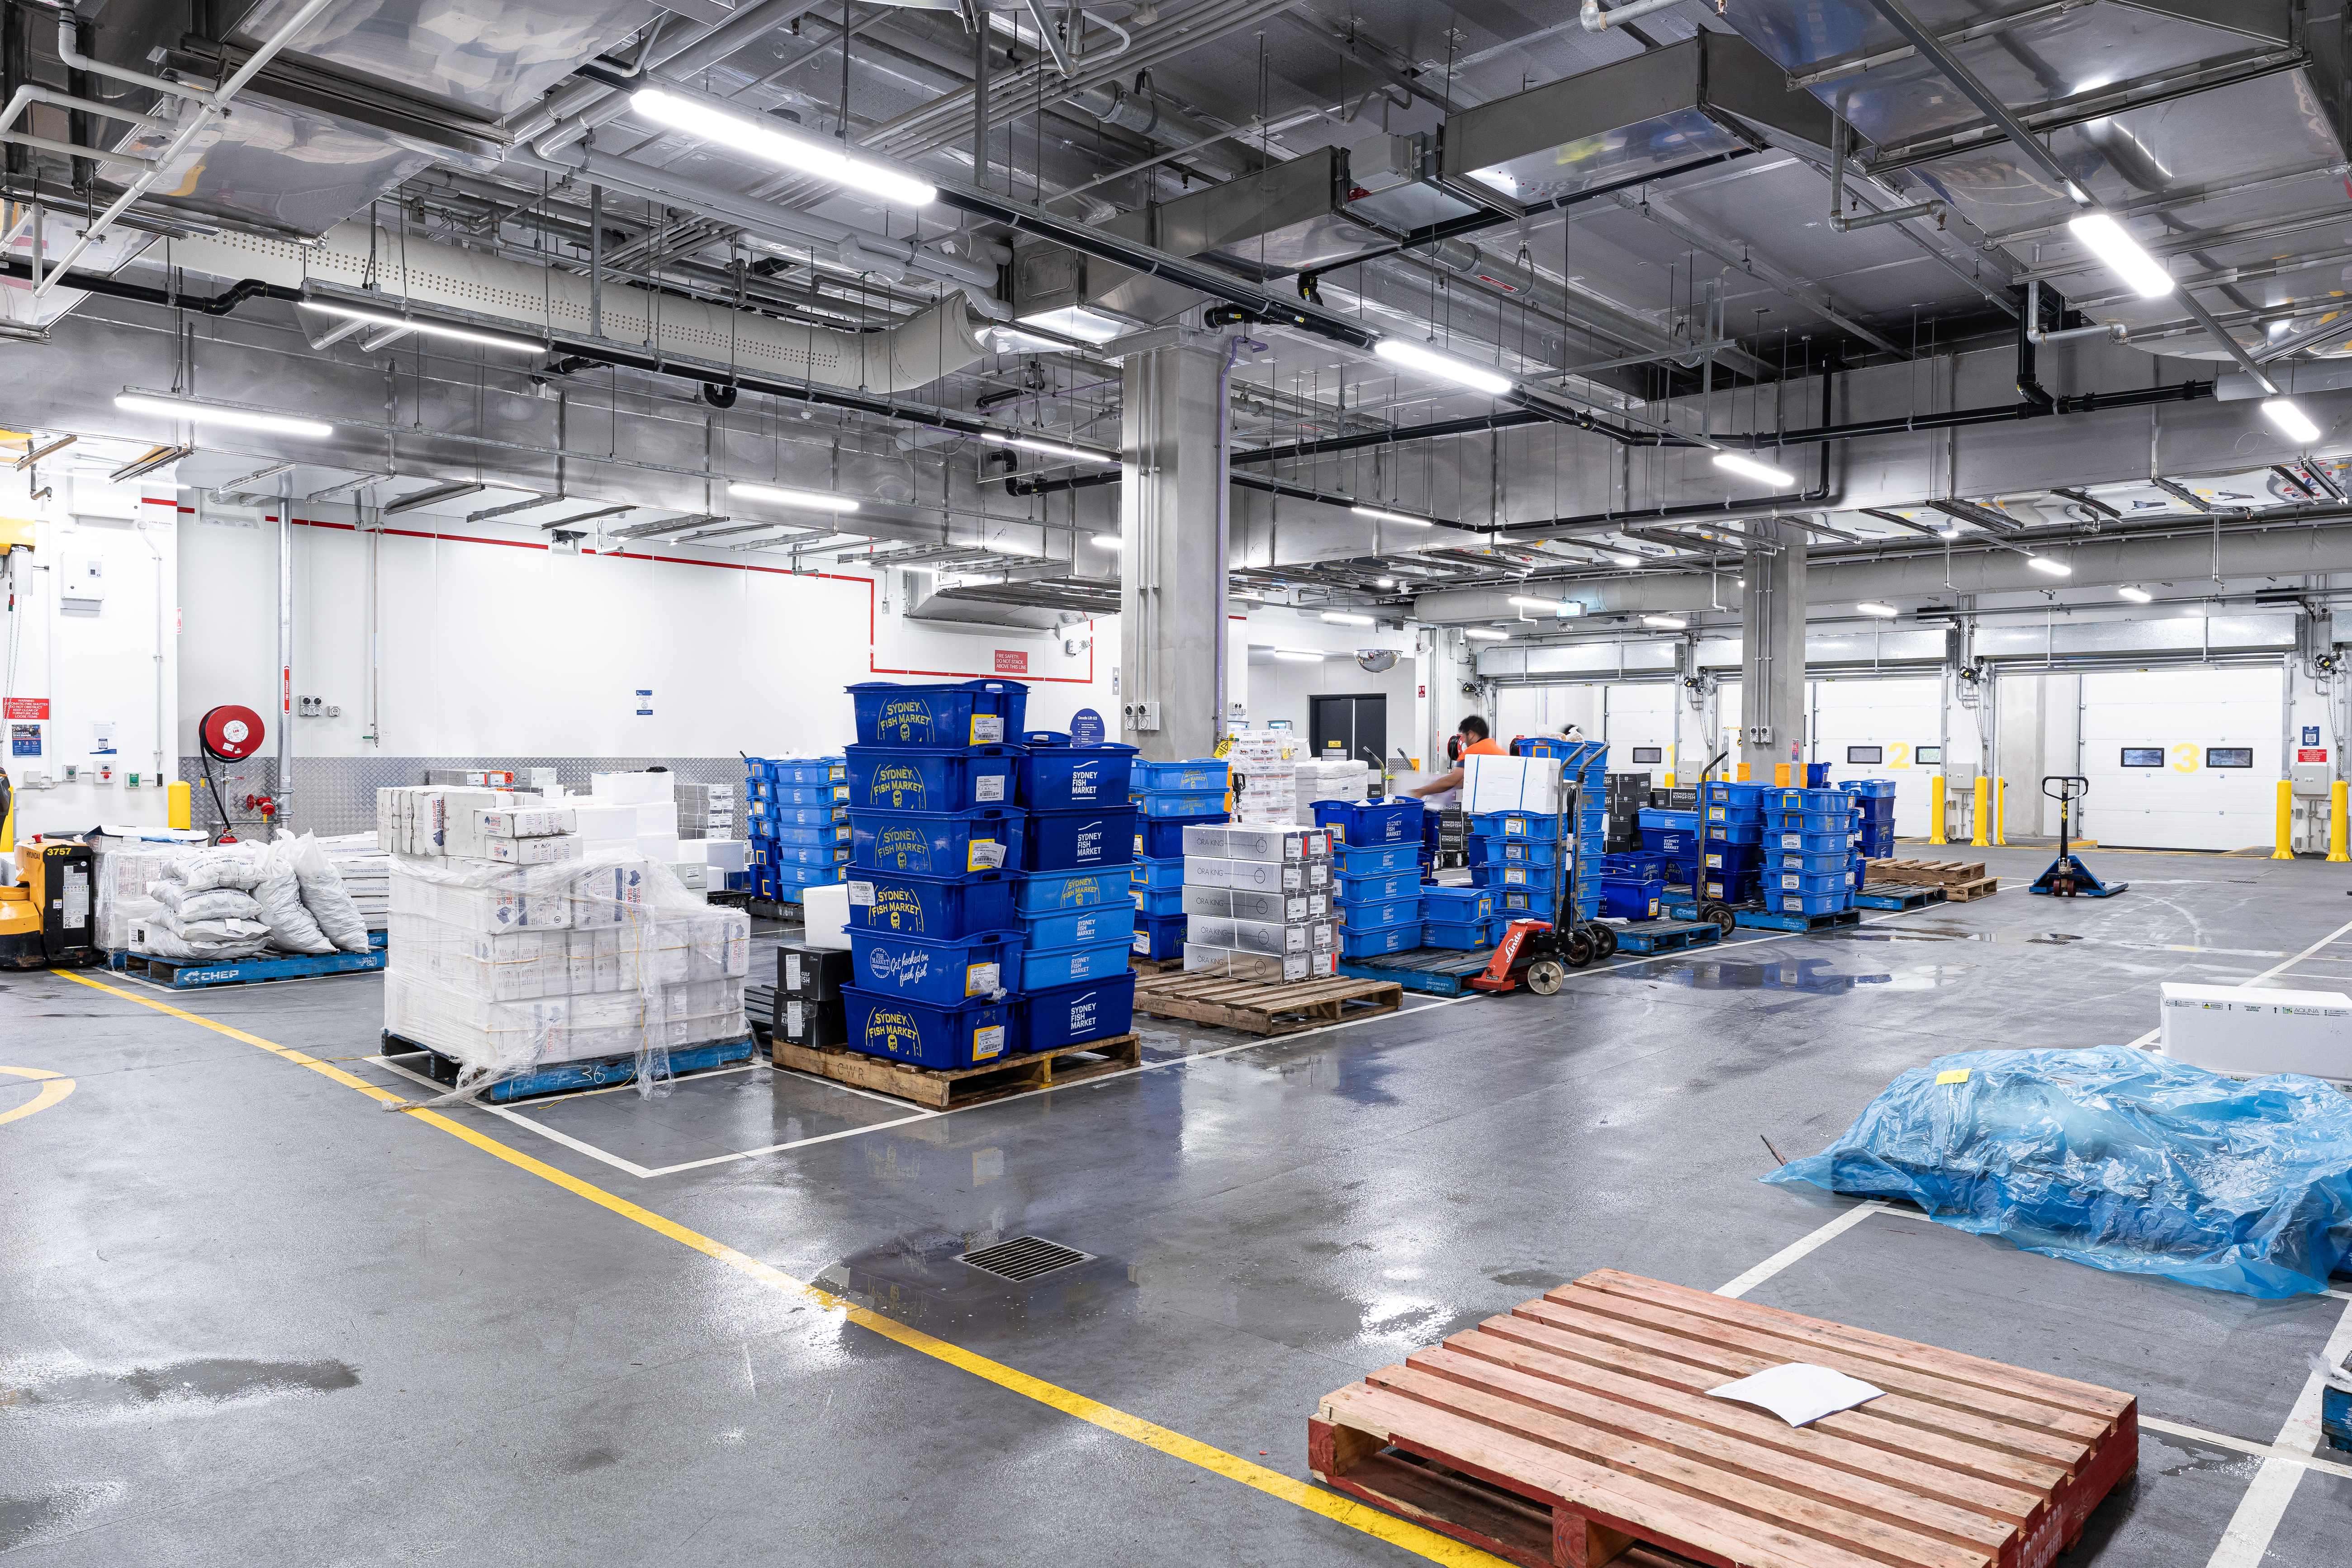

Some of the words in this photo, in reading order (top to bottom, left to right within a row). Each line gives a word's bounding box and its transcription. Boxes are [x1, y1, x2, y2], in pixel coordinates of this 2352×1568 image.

[887, 702, 920, 715] SYDNEY
[880, 718, 897, 731] FISH
[898, 714, 930, 725] MARKET
[1887, 742, 1910, 769] 2
[2172, 743, 2199, 773] 3
[1072, 786, 1097, 794] MARKET
[1077, 832, 1102, 841] SYDNEY
[1077, 840, 1091, 848] FISH
[26, 851, 40, 860] HYUNDAI
[47, 848, 71, 856] 3757
[1077, 847, 1101, 857] MARKET
[1068, 878, 1091, 890] SYDNEY
[877, 891, 910, 902] SYDNEY
[1063, 891, 1074, 900] FISH
[872, 904, 888, 917] FISH
[889, 902, 919, 915] MARKET
[1505, 931, 1522, 963] Linde
[872, 957, 889, 966] MARKET
[890, 957, 901, 976] Get
[901, 950, 922, 966] hooked
[921, 952, 929, 961] on
[1071, 956, 1090, 964] SYDNEY
[201, 970, 239, 981] CHEP
[900, 967, 914, 987] fresh
[915, 963, 927, 983] fish
[1071, 966, 1089, 975] MARKET
[1071, 1003, 1096, 1015] SYDNEY
[875, 1013, 907, 1025] SYDNEY
[1071, 1012, 1085, 1023] FISH
[1071, 1017, 1096, 1030] MARKET
[868, 1027, 885, 1038] FISH
[886, 1025, 917, 1040] MARKET
[572, 1066, 605, 1084] 36
[837, 1063, 864, 1081] CWR
